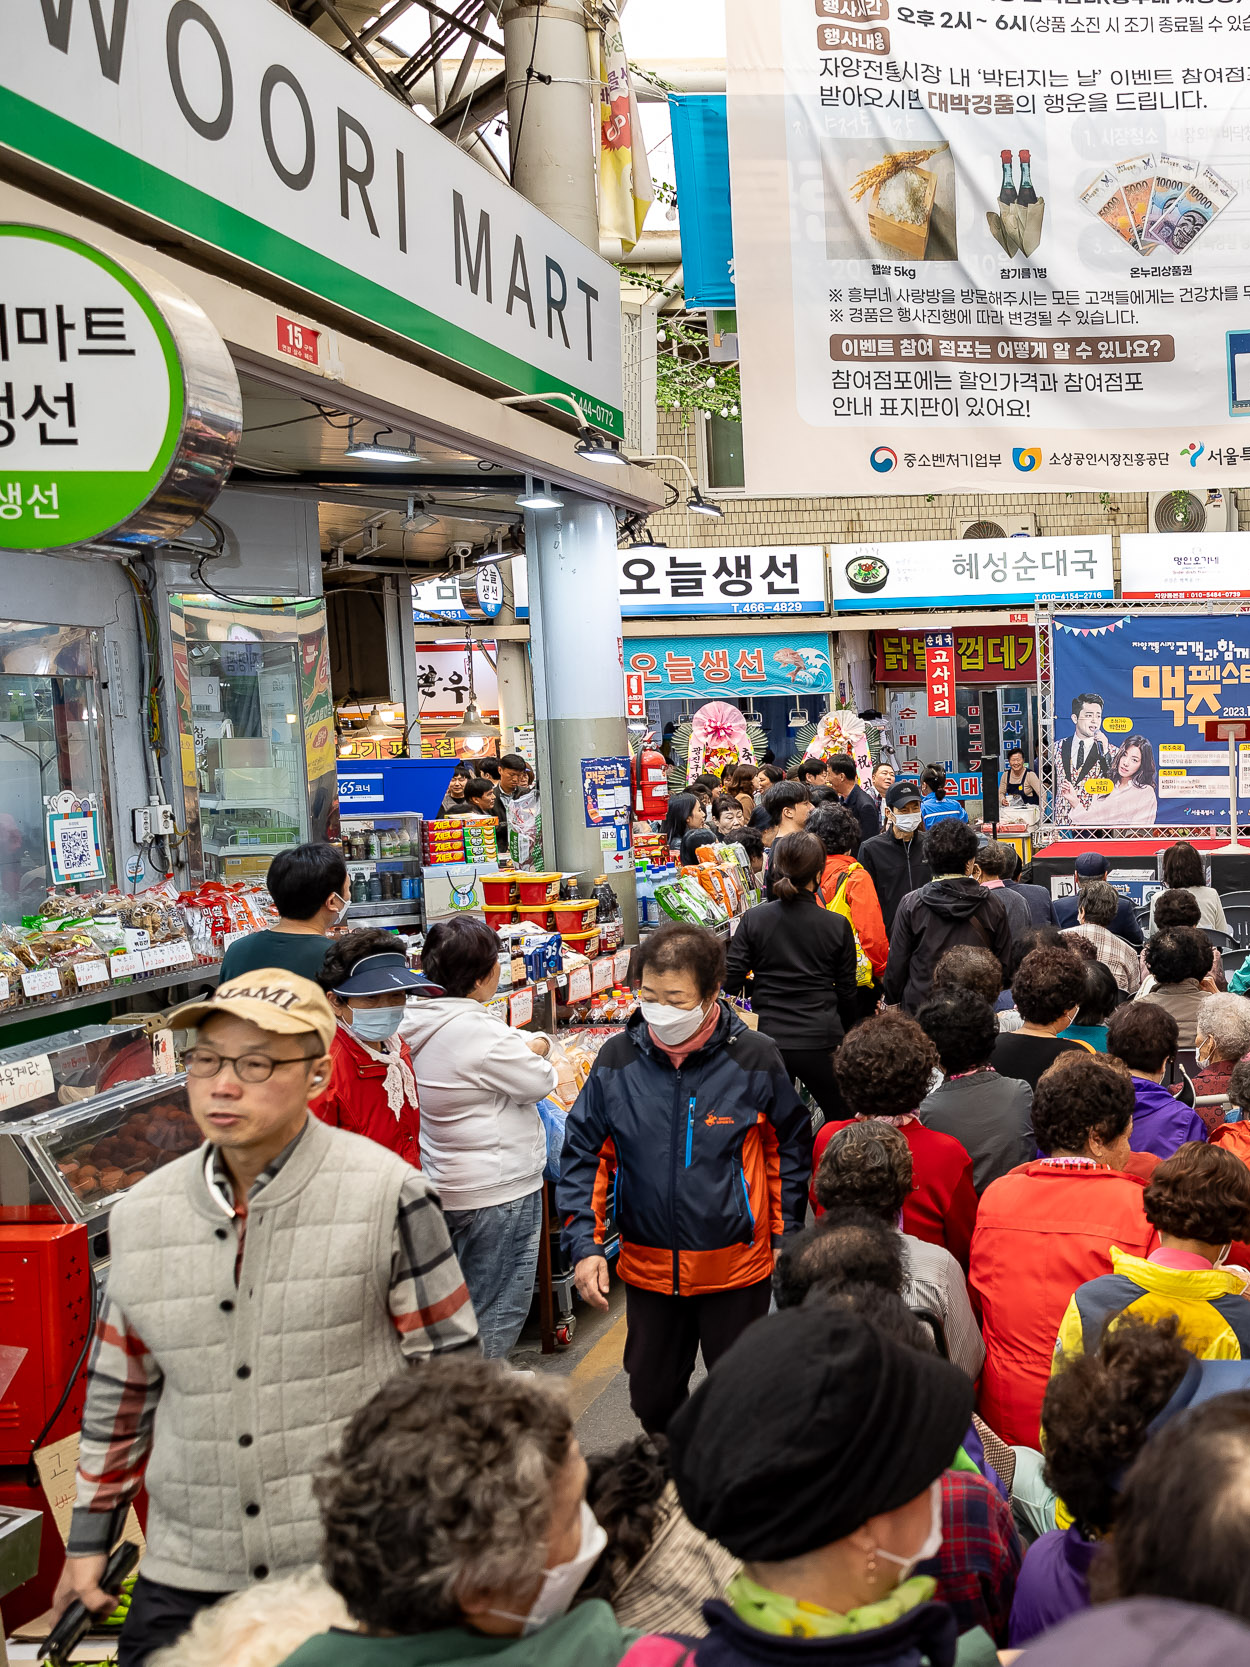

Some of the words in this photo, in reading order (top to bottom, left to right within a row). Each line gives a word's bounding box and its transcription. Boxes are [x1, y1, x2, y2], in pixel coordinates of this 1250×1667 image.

[897, 6, 935, 28] 오후
[1070, 16, 1101, 33] 소진
[1105, 16, 1119, 33] 시
[1124, 16, 1154, 33] 조기
[1159, 16, 1203, 33] 종료될
[1208, 17, 1223, 32] 수
[823, 28, 885, 50] 행사내용
[819, 57, 942, 84] 자양전통시장
[950, 68, 970, 87] 내
[1110, 69, 1174, 86] 이벤트
[819, 85, 925, 110] 받아오시면
[927, 91, 1036, 115] 대박경품의
[1044, 93, 1108, 113] 행운을
[1116, 90, 1208, 111] 드립니다.
[1124, 181, 1148, 195] 5000
[1156, 177, 1183, 191] 10000
[1189, 186, 1212, 209] 10000
[452, 188, 600, 362] MART
[871, 264, 892, 276] 햅쌀
[894, 266, 917, 281] 5kg
[1000, 267, 1031, 279] 참기름
[1129, 265, 1192, 280] 온누리상품권
[847, 288, 892, 303] 흥부네
[896, 287, 956, 304] 사랑방을
[960, 288, 1048, 306] 방문해주시는
[1051, 290, 1081, 306] 모든
[1084, 288, 1175, 305] 고객들에게는
[1179, 285, 1239, 303] 건강차를
[848, 308, 893, 323] 경품은
[897, 308, 972, 325] 행사진행에
[975, 309, 1005, 325] 따라
[1008, 311, 1053, 326] 변경될
[1057, 311, 1072, 325] 수
[1075, 310, 1139, 325] 있습니다.
[286, 323, 303, 349] 15
[842, 339, 895, 356] 이벤트
[900, 339, 933, 357] 참여
[939, 340, 992, 358] 점포는
[997, 340, 1048, 359] 어떻게
[1053, 341, 1070, 359] 알
[1075, 341, 1092, 359] 수
[1097, 340, 1159, 359] 있나요?
[832, 369, 953, 391] 참여점포에는
[959, 371, 1058, 392] 할인가격과
[1064, 371, 1144, 392] 참여점포
[833, 397, 871, 417] 안내
[879, 397, 959, 417] 표지판이
[965, 397, 1031, 418] 있어요!
[904, 452, 1001, 468] 중소벤처기업부
[1049, 452, 1169, 467] 소상공인시장진흥공단
[620, 553, 800, 597] 오늘생선
[952, 549, 1098, 583] 혜성순대국
[731, 601, 803, 613] T.466-4829
[926, 634, 953, 646] 순대국
[1175, 641, 1218, 662] 고객과
[629, 648, 766, 683] 오늘생선
[931, 650, 950, 714] 고사머리
[741, 749, 753, 762] 축
